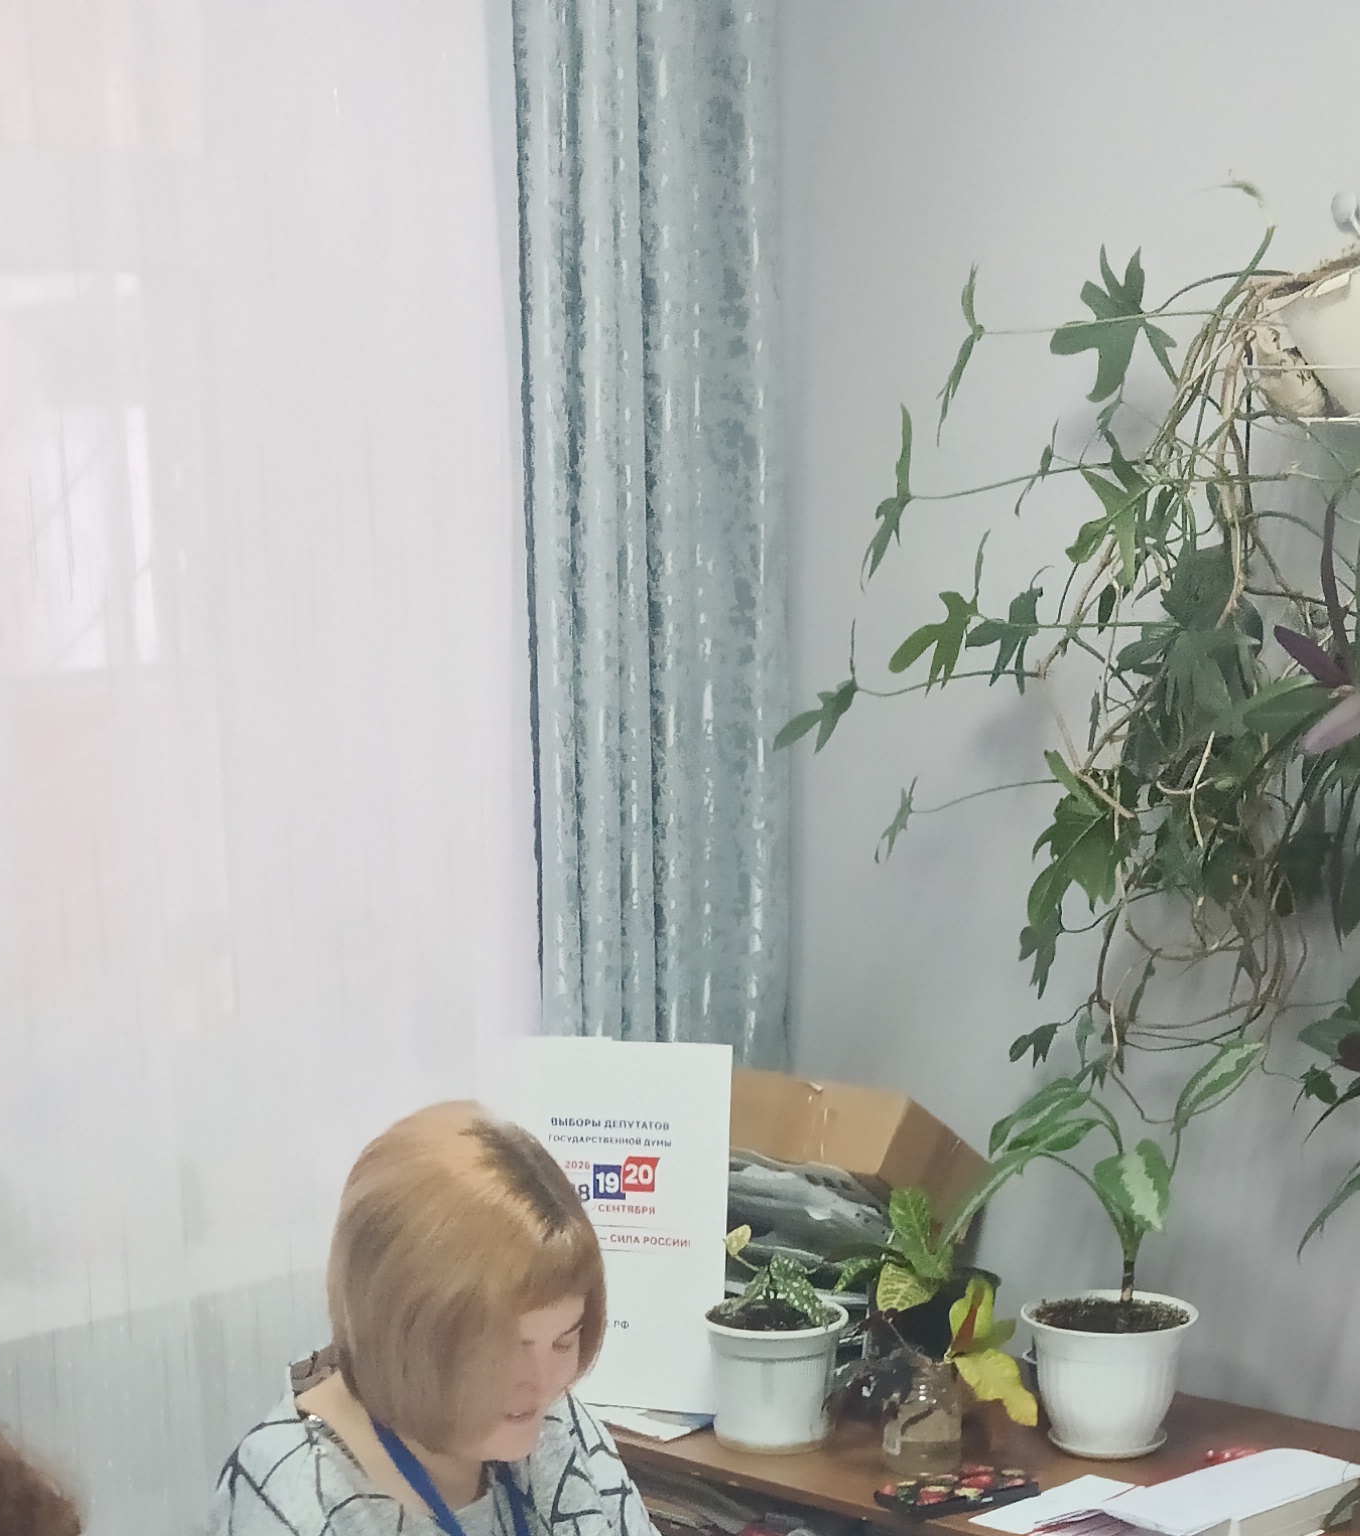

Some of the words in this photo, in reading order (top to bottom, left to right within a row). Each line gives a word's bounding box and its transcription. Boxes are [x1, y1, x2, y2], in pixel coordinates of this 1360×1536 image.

[551, 1117, 601, 1128] ВЫБОРЫ
[603, 1119, 670, 1131] ДЕПУТАТОВ
[548, 1134, 641, 1146] ГОСУДАРСТВЕННОЙ
[643, 1137, 672, 1148] ДУМЫ
[565, 1160, 591, 1170] 2026
[595, 1172, 620, 1194] 19
[624, 1163, 654, 1185] 20
[597, 1203, 656, 1215] СЕНТЯБРЯ
[610, 1233, 640, 1244] СИЛА
